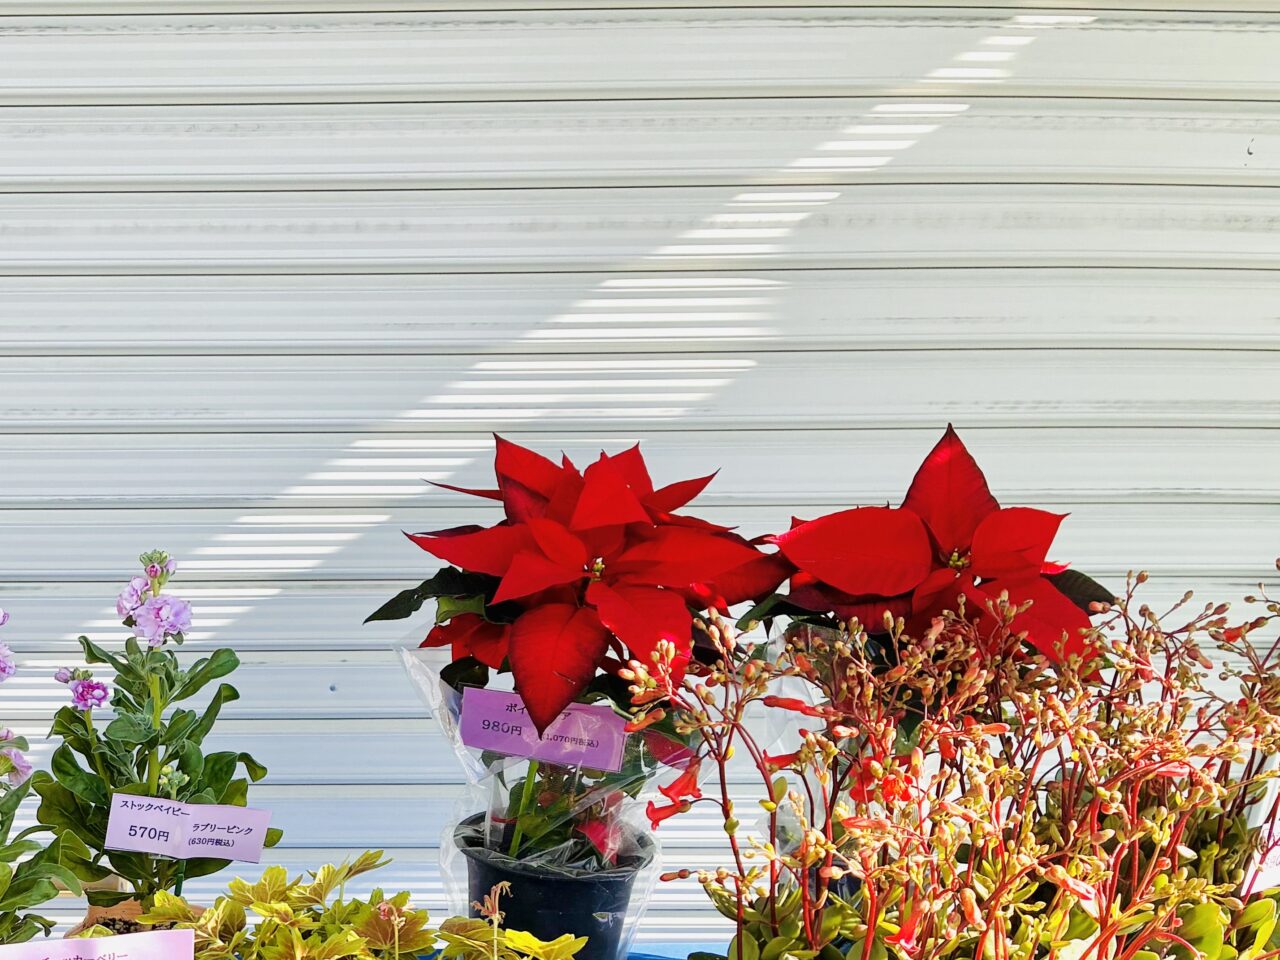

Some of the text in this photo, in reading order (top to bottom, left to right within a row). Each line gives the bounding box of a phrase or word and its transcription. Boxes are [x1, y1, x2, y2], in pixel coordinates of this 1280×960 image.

[505, 702, 572, 720] ポイア
[481, 719, 523, 737] 980円
[120, 800, 191, 817] ストックベイビー
[128, 825, 170, 842] 570円
[192, 823, 254, 836] ラブリーピンク
[188, 837, 235, 847] (630円税込)
